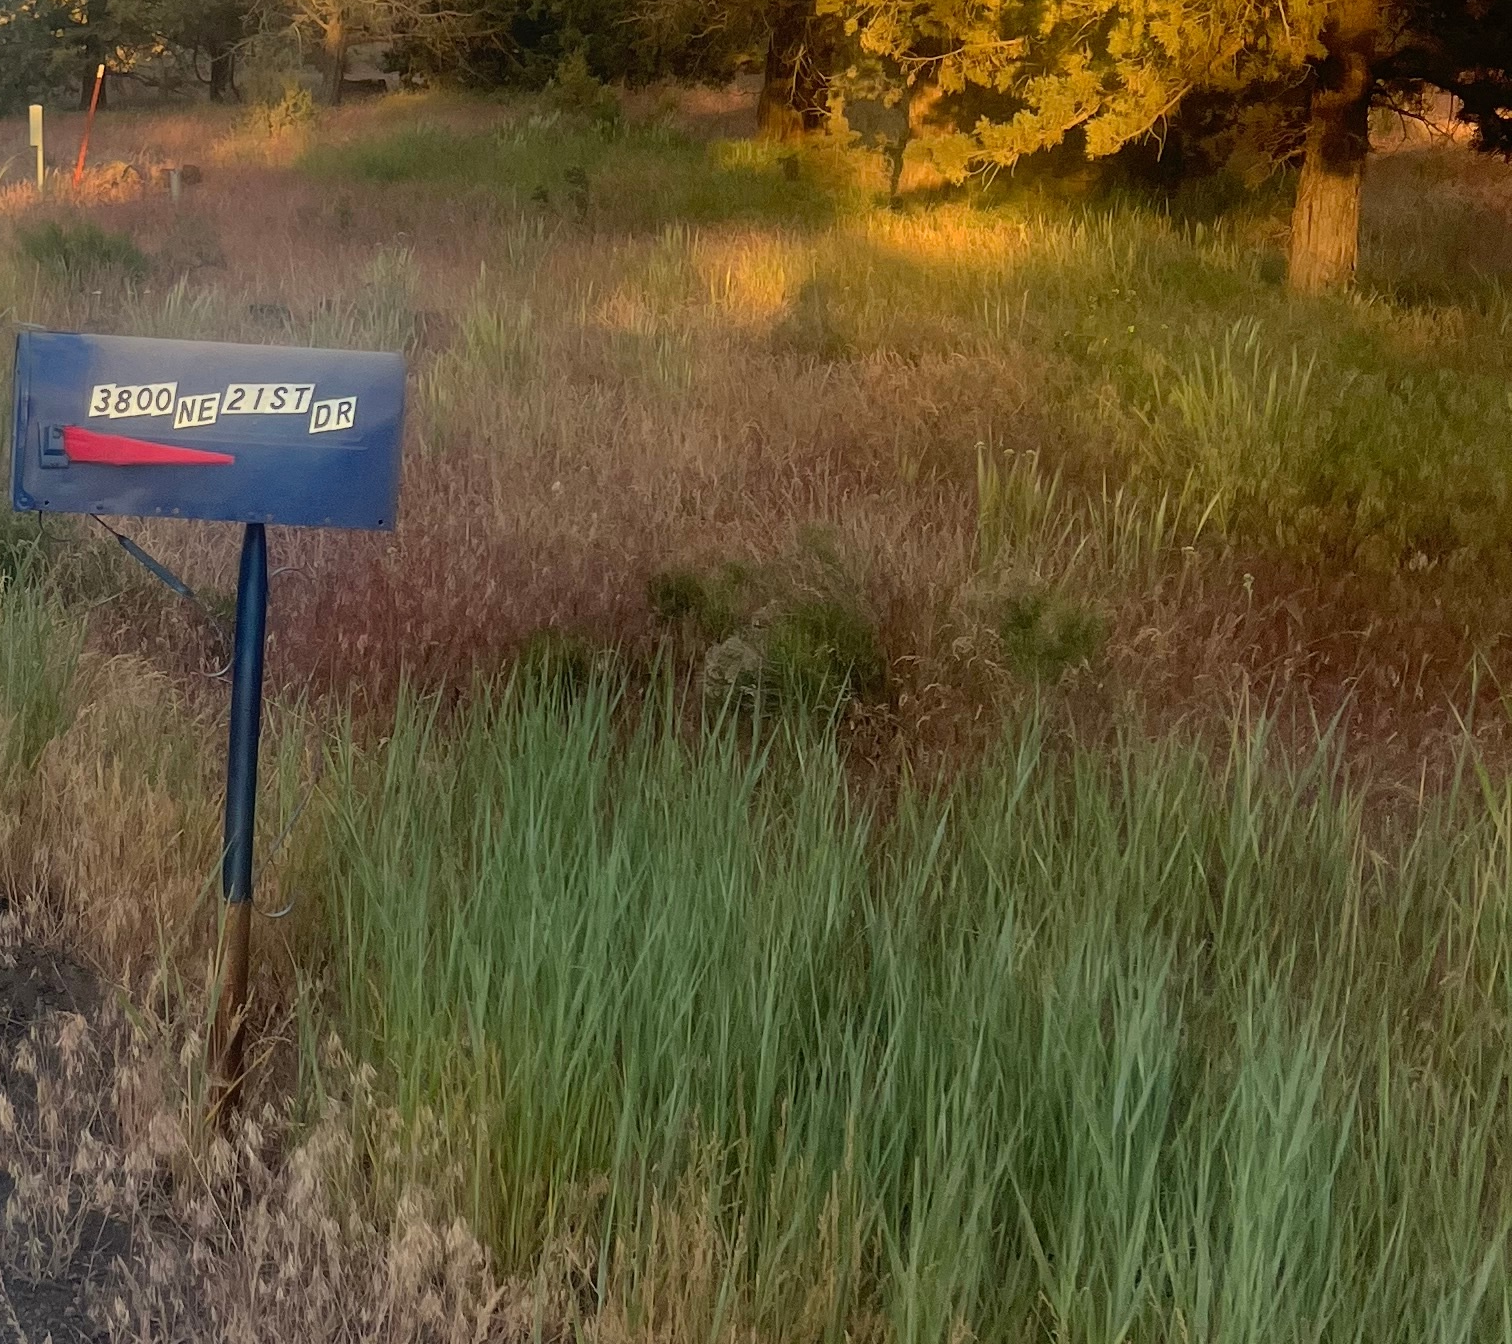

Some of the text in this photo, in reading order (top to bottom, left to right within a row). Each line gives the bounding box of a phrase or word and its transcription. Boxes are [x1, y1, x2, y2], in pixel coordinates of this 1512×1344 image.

[94, 387, 353, 429] 3800 NE 21ST DR
